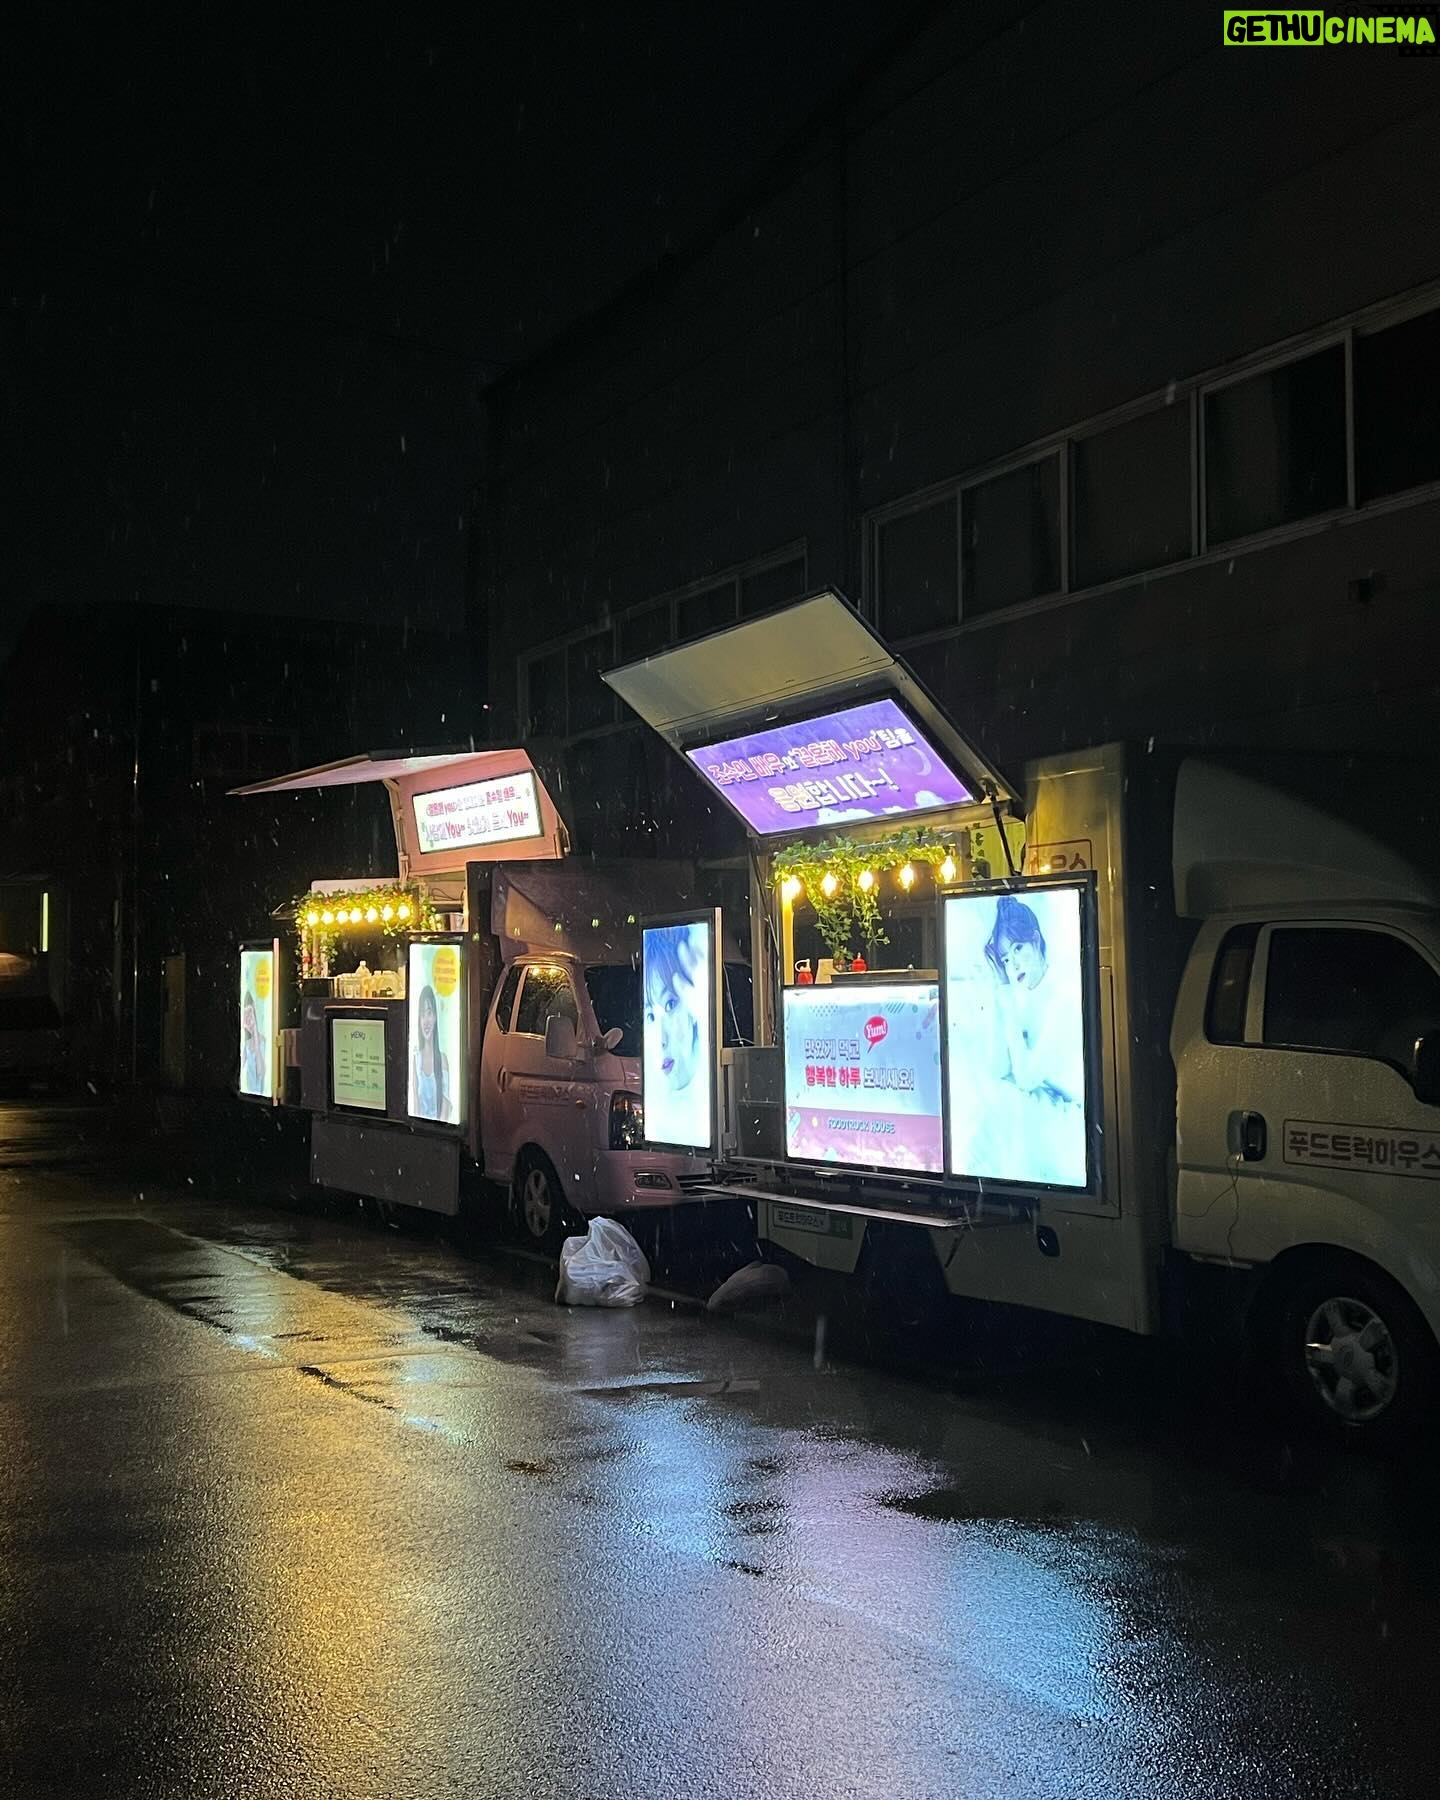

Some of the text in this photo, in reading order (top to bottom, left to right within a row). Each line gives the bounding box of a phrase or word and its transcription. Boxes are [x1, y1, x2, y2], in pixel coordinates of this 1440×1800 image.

[708, 761, 757, 785] 조수민
[866, 1021, 887, 1038] Yum!
[804, 1038, 861, 1061] 맛있게 먹고
[804, 1064, 915, 1091] 행복한 하루 보내세요!
[828, 1116, 870, 1132] FOODTRUCK
